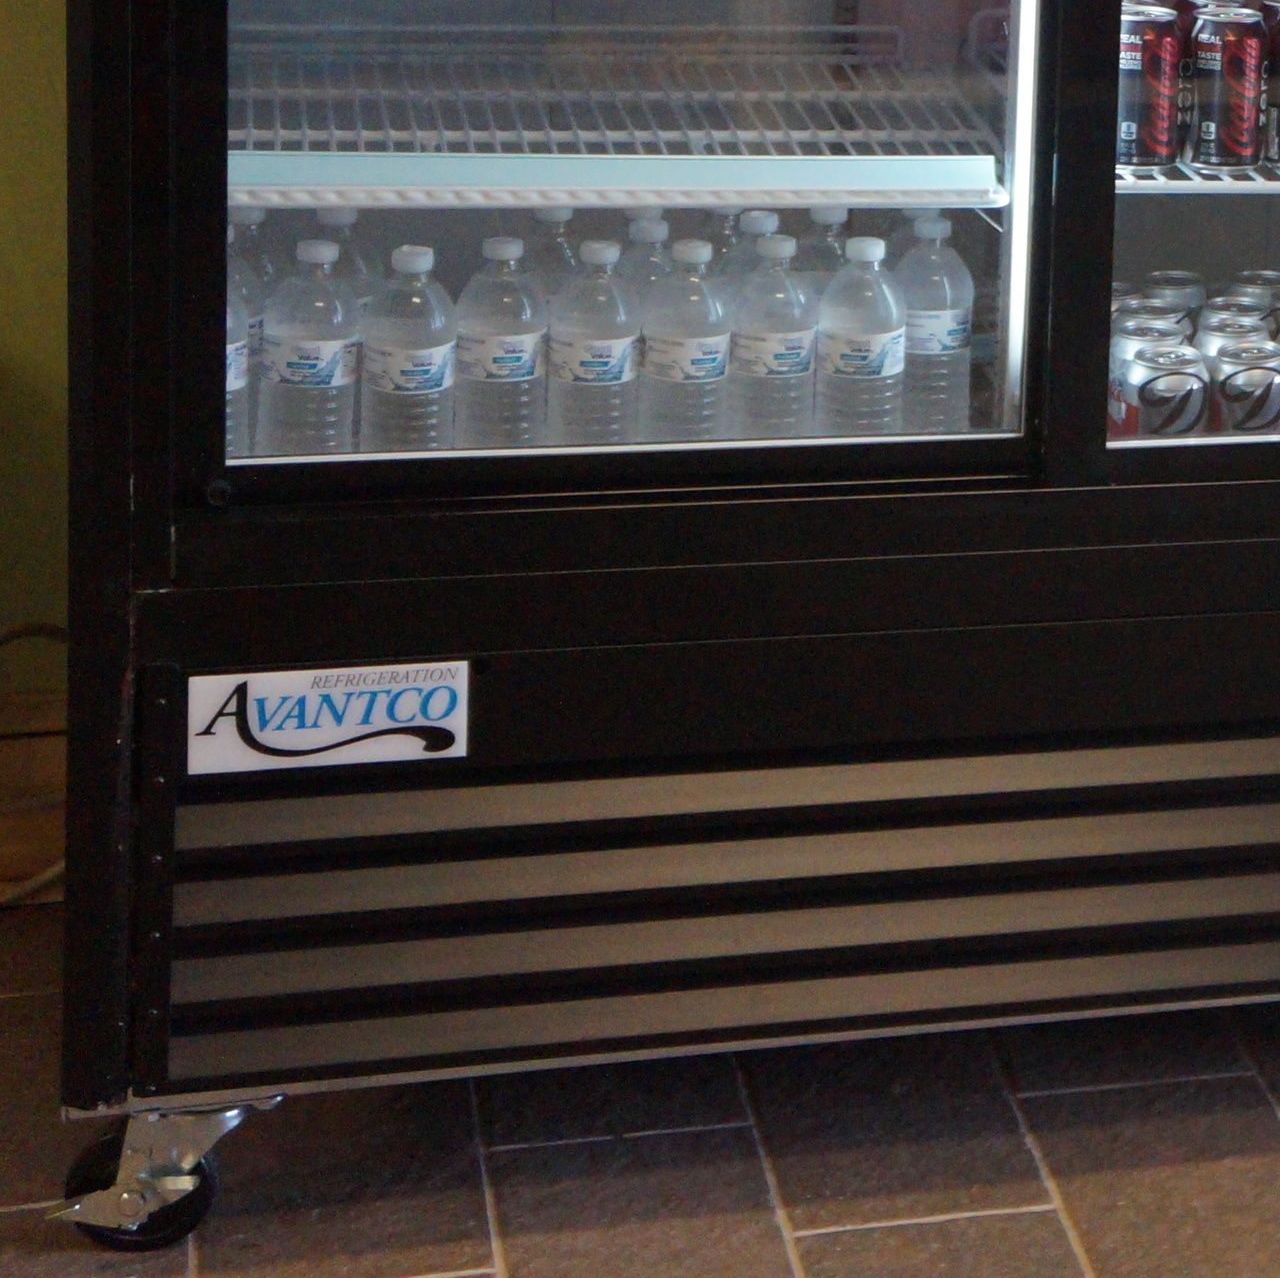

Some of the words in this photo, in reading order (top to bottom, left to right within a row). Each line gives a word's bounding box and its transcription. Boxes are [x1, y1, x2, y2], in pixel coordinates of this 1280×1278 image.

[1119, 51, 1143, 61] ASTE
[310, 666, 459, 690] REFRIGERATION
[194, 680, 459, 742] AVANTCO
